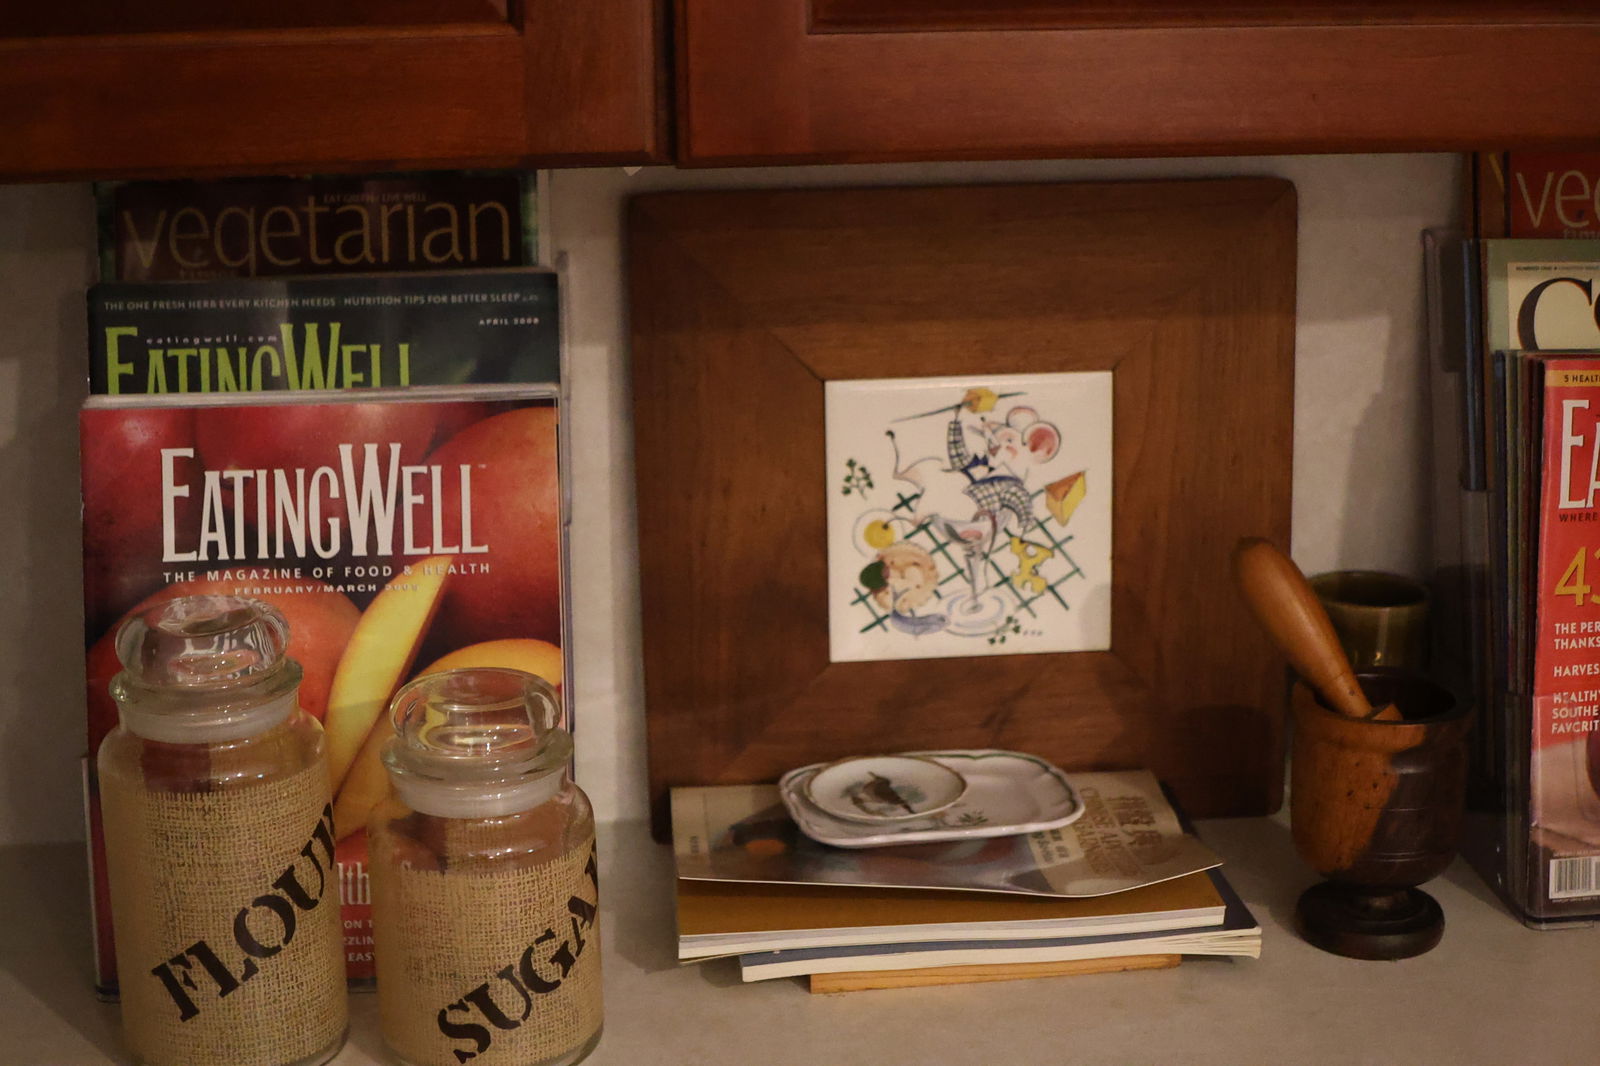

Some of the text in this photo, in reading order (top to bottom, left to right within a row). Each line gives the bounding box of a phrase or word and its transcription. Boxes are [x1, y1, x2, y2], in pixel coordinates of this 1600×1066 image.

[121, 195, 511, 277] vegetarian
[104, 301, 124, 311] THE
[126, 301, 149, 311] ONE
[152, 300, 185, 310] FRESH
[188, 300, 216, 310] HERB
[219, 299, 250, 309] EVERY
[253, 298, 299, 308] KITCHEN
[302, 297, 336, 307] NEEDS
[344, 296, 401, 306] NUTRITION
[404, 295, 425, 305] TIPS
[427, 295, 448, 304] FOR
[451, 293, 488, 304] BETTER
[489, 293, 521, 303] SLEEP
[478, 317, 509, 326] APRIL
[1572, 374, 1600, 383] HEALT
[1559, 512, 1598, 522] WHERE
[163, 563, 490, 583] THE MAGAZINE OF FOOD & HEALTH
[235, 584, 376, 595] FEBRUARY/MARCH
[1554, 622, 1577, 635] THE
[1553, 663, 1600, 677] HARVES
[1552, 705, 1599, 719] SOUTHE
[1551, 720, 1600, 734] FAVORIT
